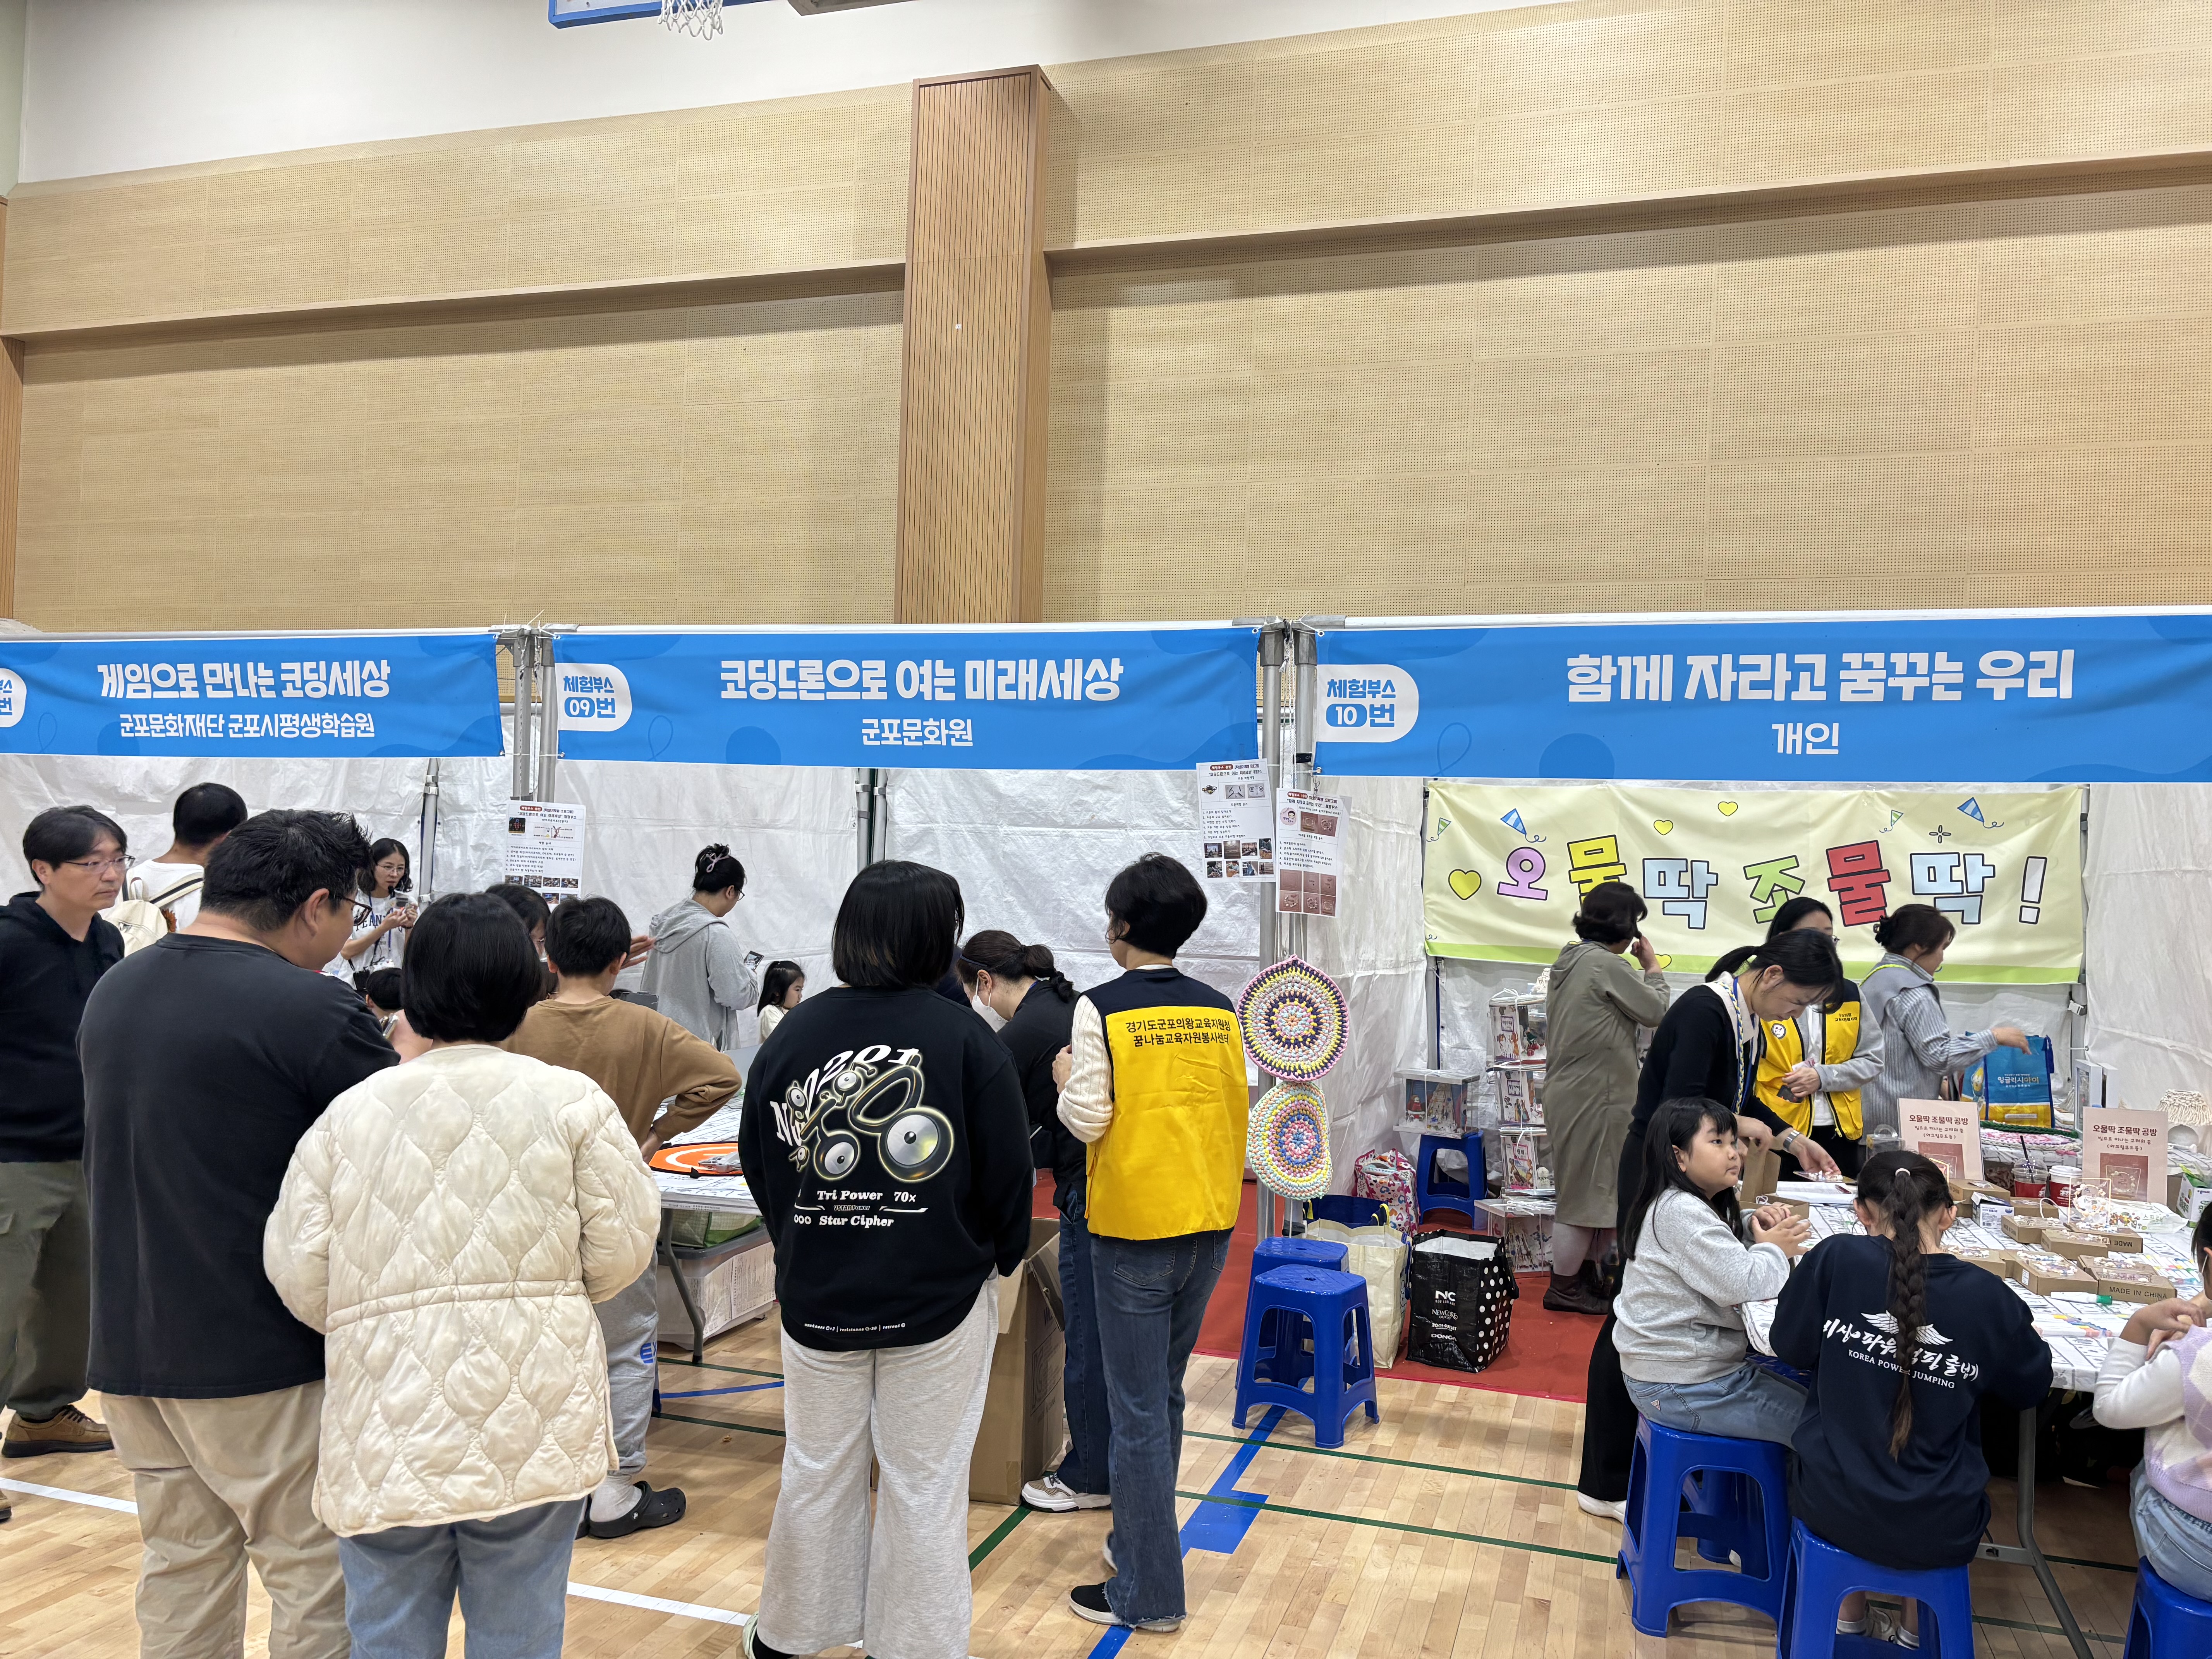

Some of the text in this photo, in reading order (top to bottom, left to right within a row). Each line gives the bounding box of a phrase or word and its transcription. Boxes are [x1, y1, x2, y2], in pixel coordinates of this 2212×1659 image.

[98, 659, 391, 699] 게임으로 만나는 코딩세상
[563, 675, 615, 693] 체험부스
[721, 658, 1123, 701] 코딩드론으로 여는 미래세상
[1567, 649, 2075, 702] 함께 자라고 꿈꾸는 우리
[1327, 679, 1396, 699] 체험부스
[120, 713, 376, 738] 군포문화재단 군포시평생학습원
[862, 718, 973, 746] 군포문화원
[1772, 722, 1839, 754] 개인
[1126, 1018, 1231, 1033] 경기도군포의왕교육지원청
[1133, 1033, 1229, 1047] 꿈나눔교육자원봉사센터
[1932, 1116, 1953, 1124] 조물딱
[1954, 1117, 1969, 1125] 공방
[2093, 1125, 2157, 1137] 오물딱 조물딱 공방
[817, 1190, 837, 1200] Tri
[840, 1190, 883, 1200] Power
[819, 1215, 894, 1228] Star Cipher
[1435, 1290, 1456, 1302] NC
[2109, 1286, 2130, 1295] MADE
[1848, 1349, 1955, 1389] KOREA POWE JUMPING
